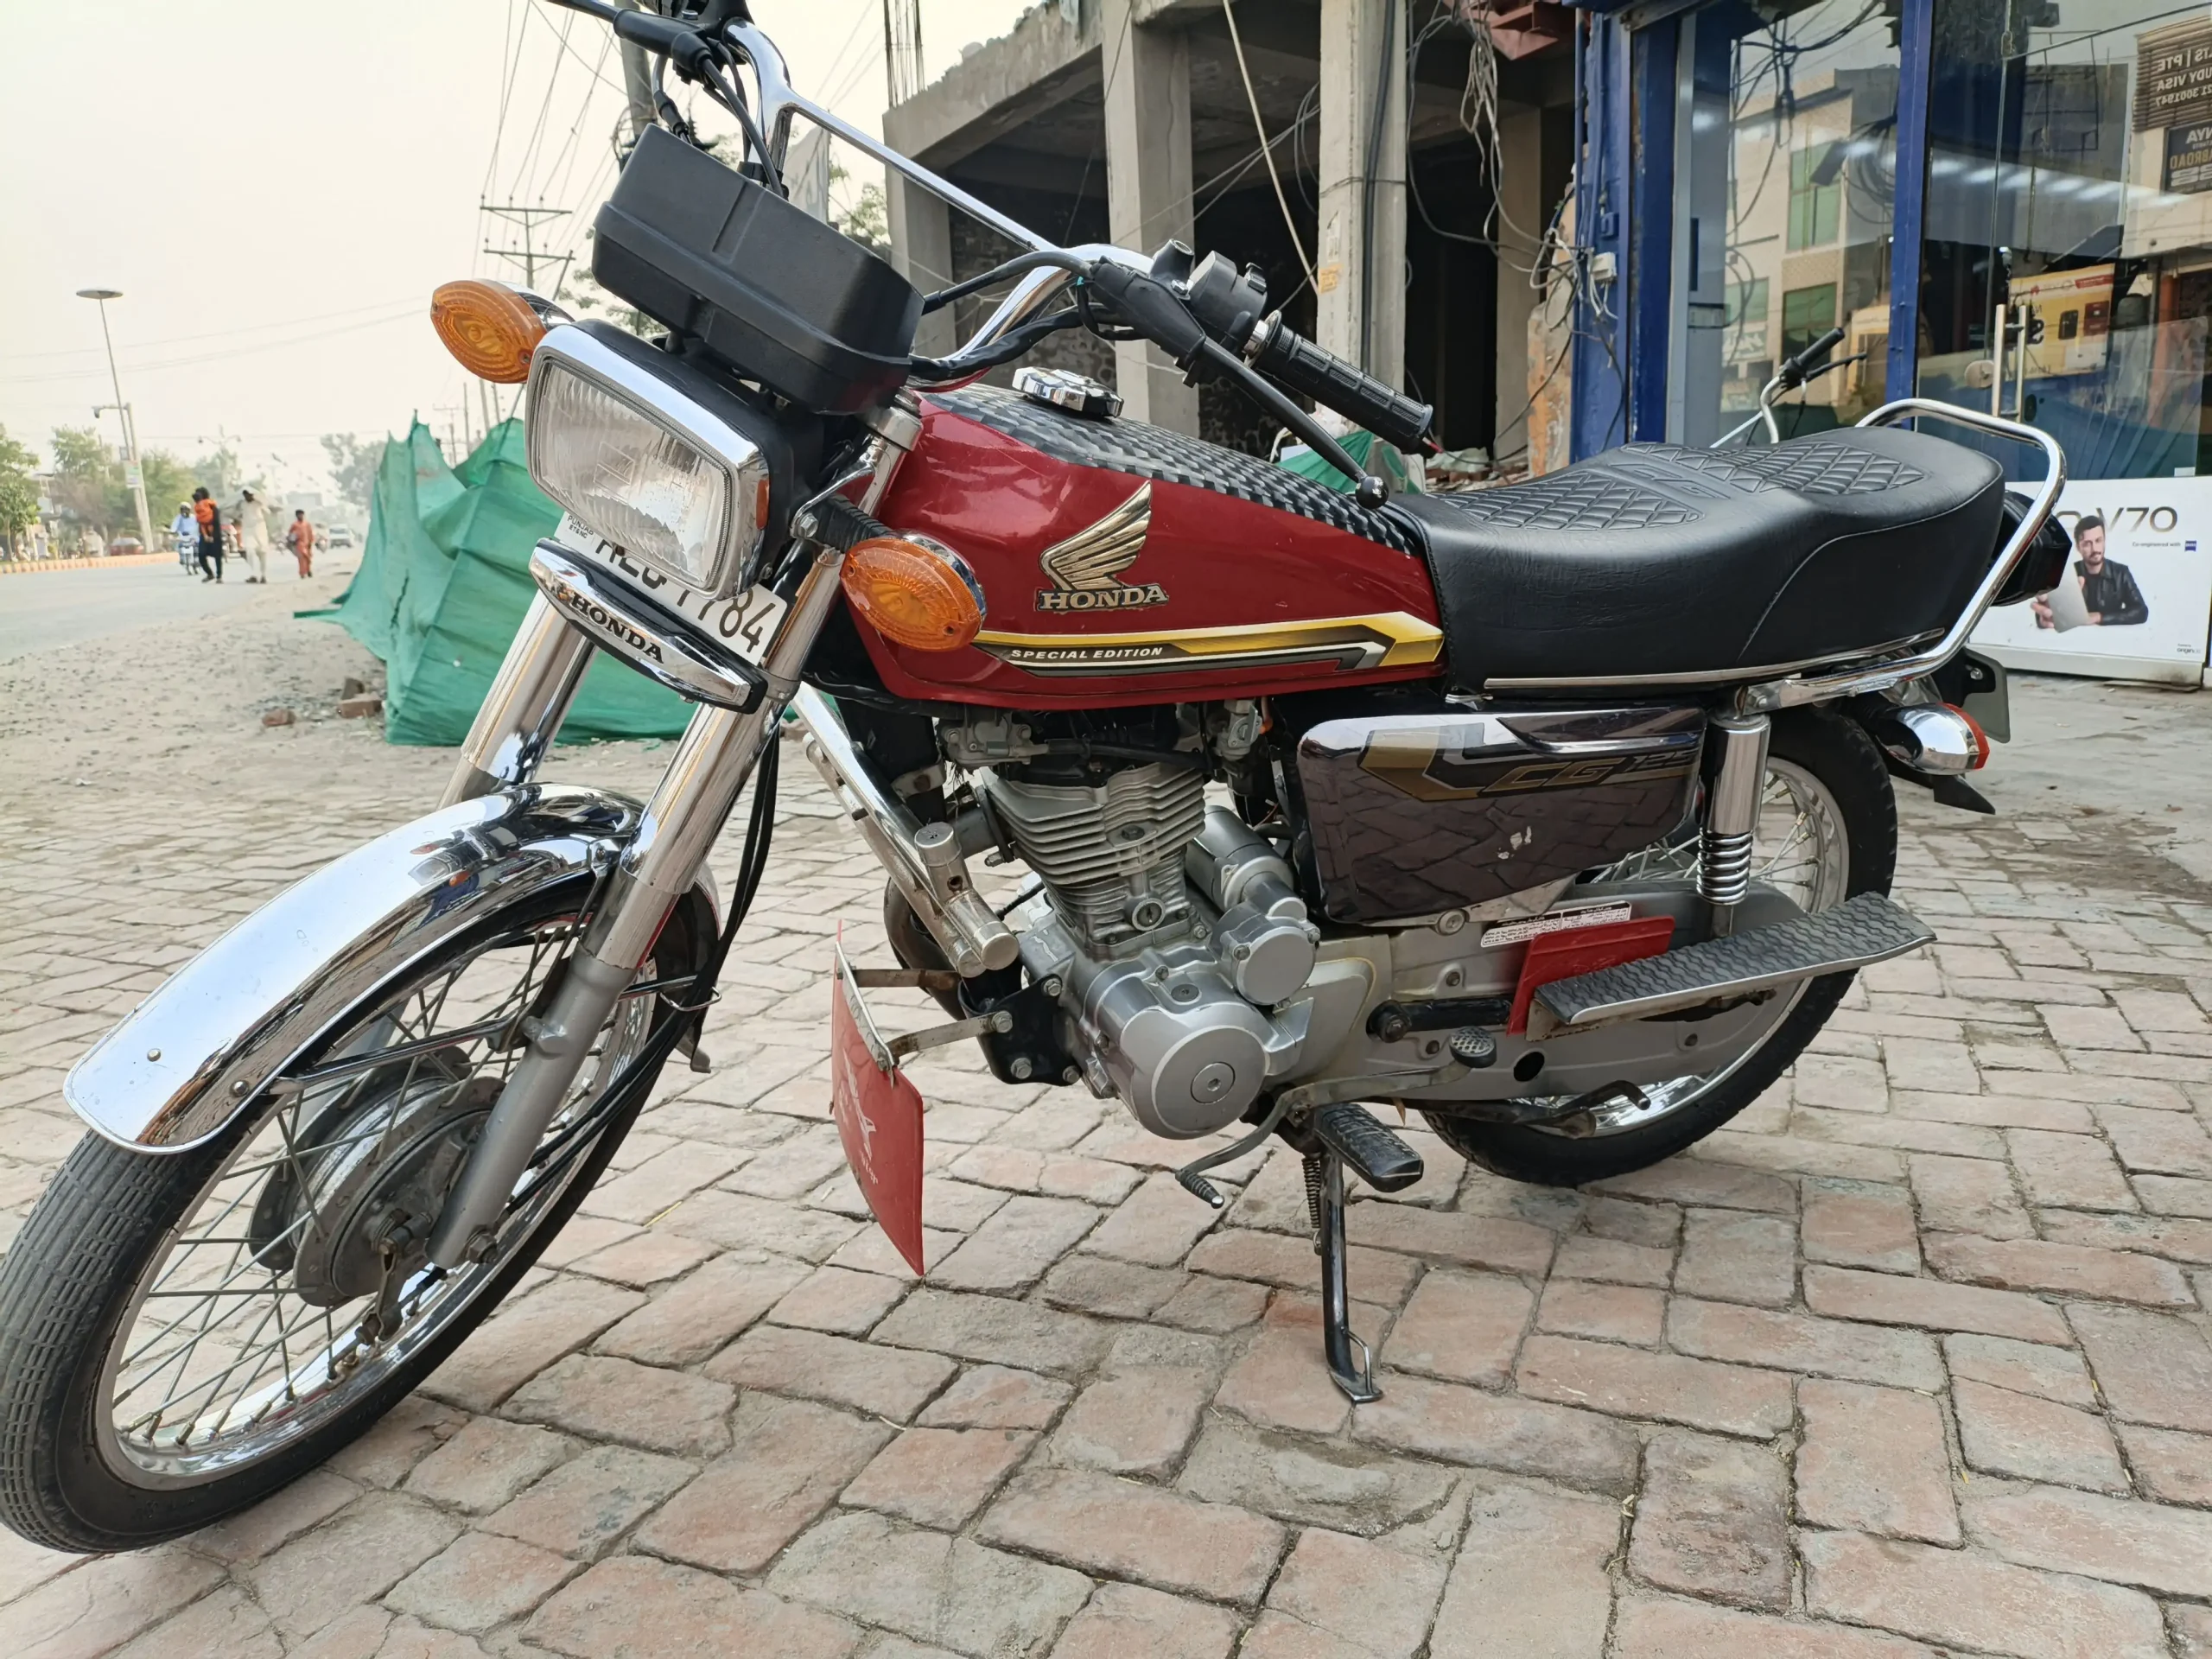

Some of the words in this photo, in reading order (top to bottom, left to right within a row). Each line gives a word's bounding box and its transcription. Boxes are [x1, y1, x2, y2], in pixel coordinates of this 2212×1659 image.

[2095, 506, 2177, 532] V70
[1039, 585, 1168, 609] HONDA
[571, 592, 664, 664] HONDA
[1011, 649, 1088, 659] SPECIAL
[1092, 647, 1163, 658] EDITION
[1481, 757, 1626, 792] CG
[1624, 748, 1700, 772] 125
